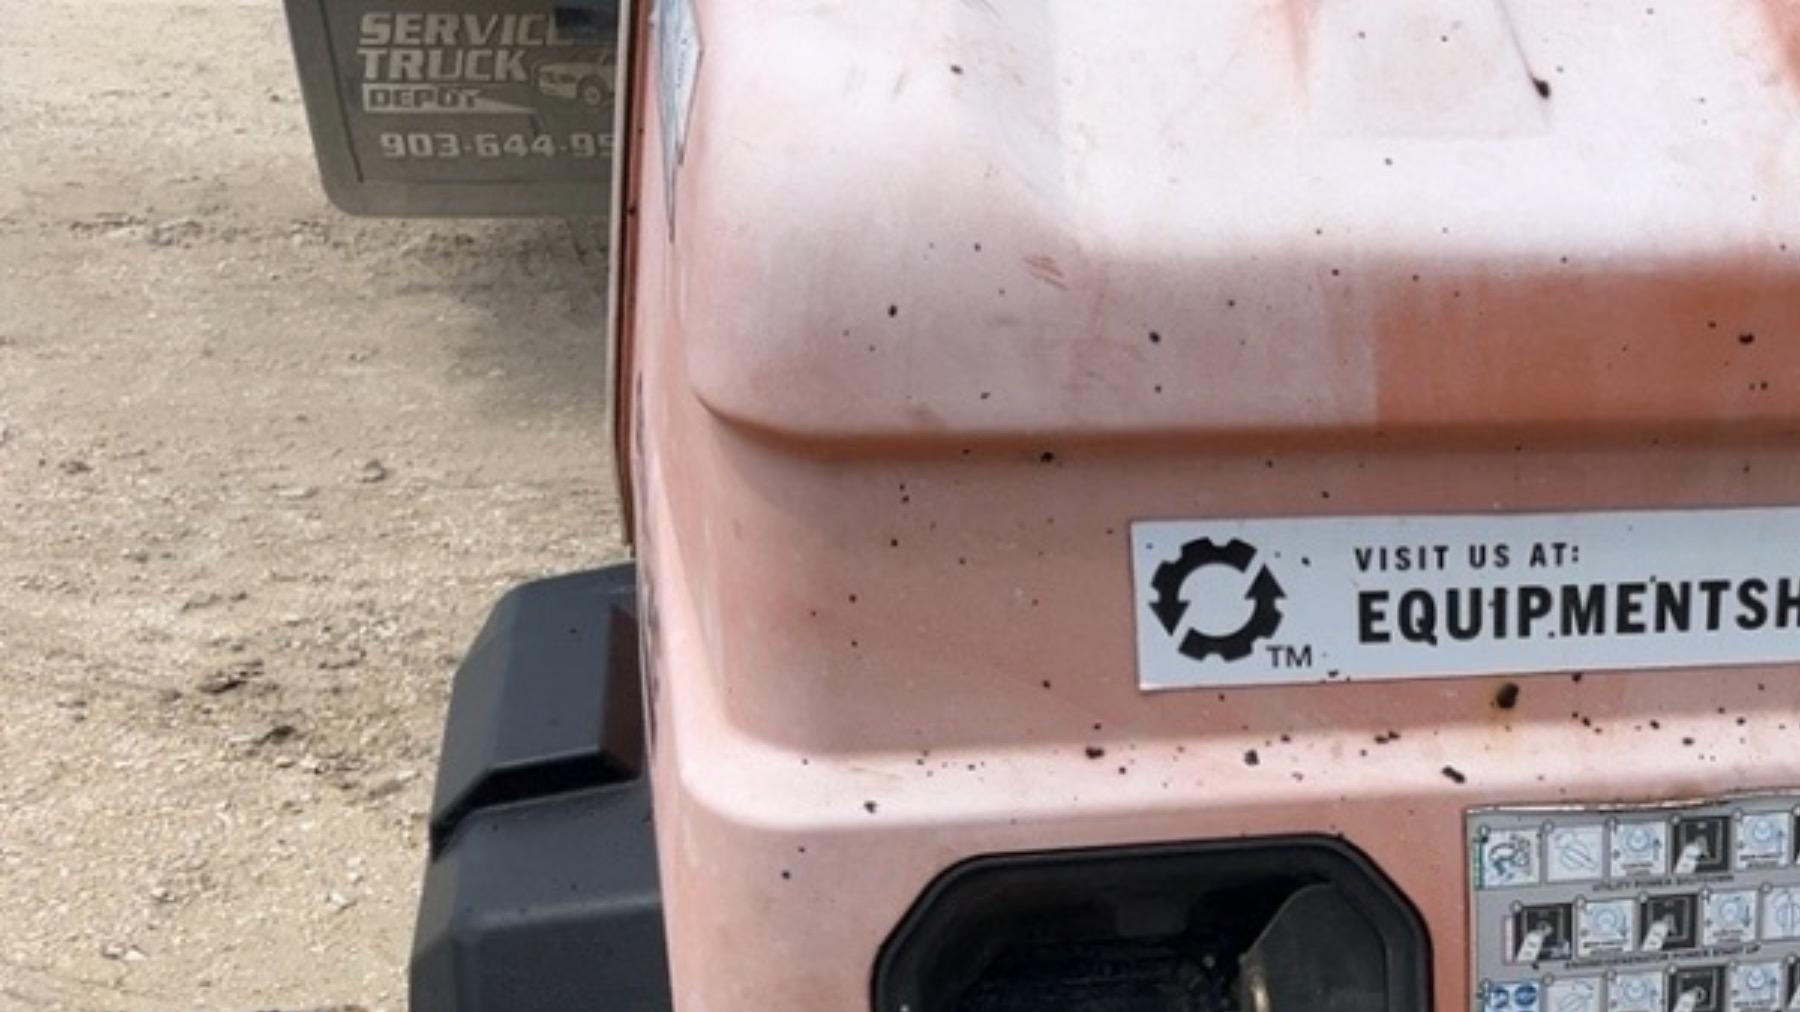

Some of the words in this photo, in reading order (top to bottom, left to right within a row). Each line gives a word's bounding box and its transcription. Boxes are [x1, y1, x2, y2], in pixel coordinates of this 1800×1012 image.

[357, 48, 528, 82] TRUCK
[366, 87, 482, 109] DEPOT
[1355, 545, 1449, 572] VISIT
[1469, 543, 1510, 569] US
[1528, 542, 1579, 568] AT:
[1265, 645, 1313, 668] TM
